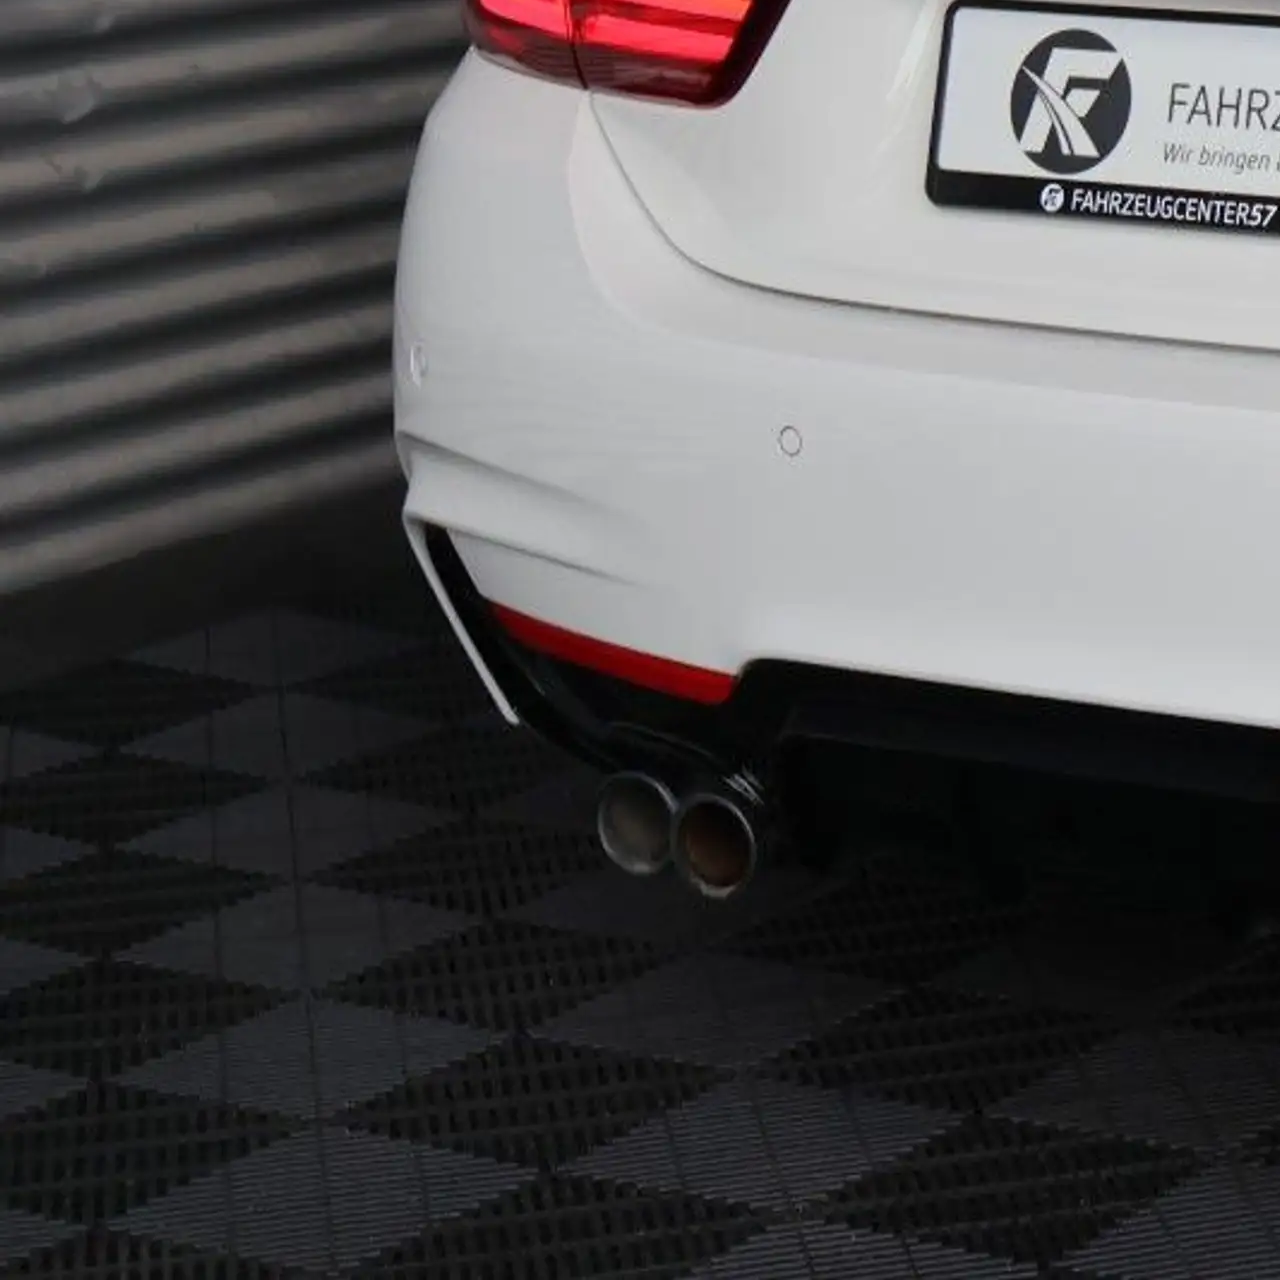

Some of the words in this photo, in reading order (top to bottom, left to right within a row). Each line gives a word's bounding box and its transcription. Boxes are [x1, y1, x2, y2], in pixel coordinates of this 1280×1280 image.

[1163, 142, 1194, 164] Wir
[1199, 146, 1271, 174] bringen
[1070, 187, 1279, 228] FAHRZEUGCENTER57
